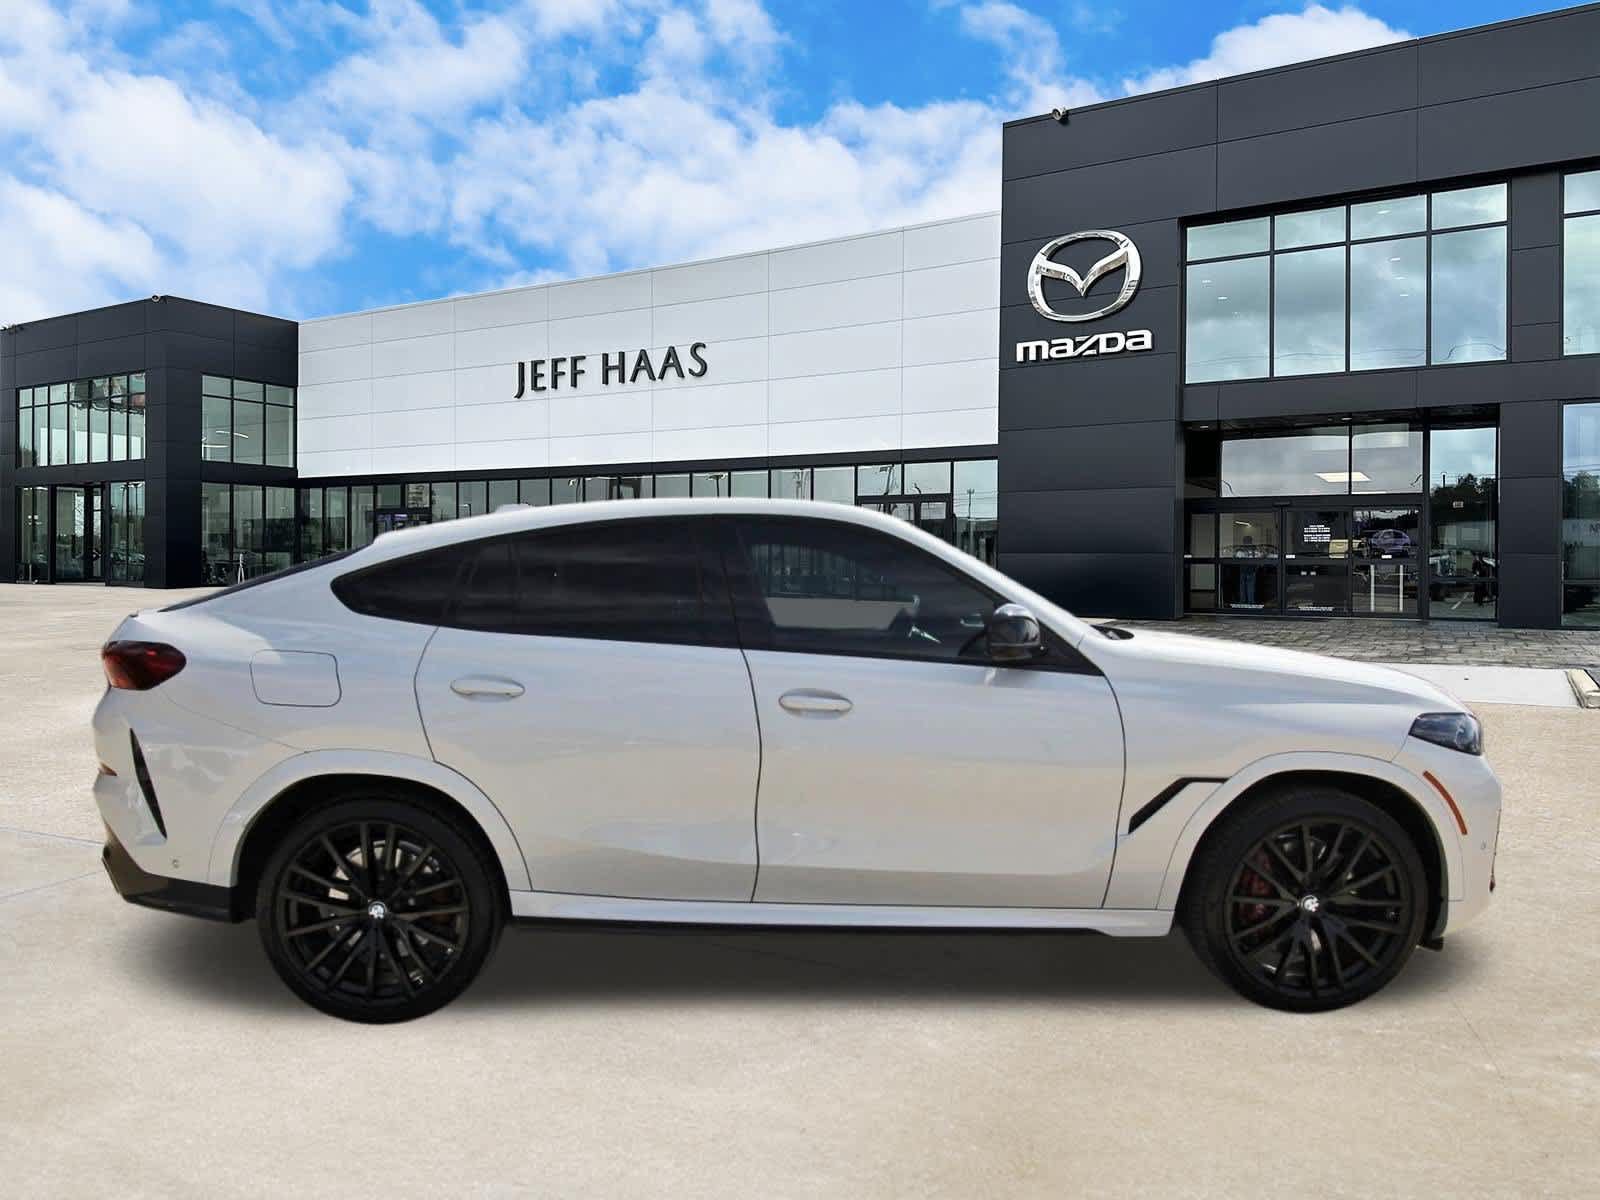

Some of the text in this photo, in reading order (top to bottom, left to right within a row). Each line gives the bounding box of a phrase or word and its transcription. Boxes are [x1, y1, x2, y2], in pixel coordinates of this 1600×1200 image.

[1016, 329, 1153, 362] mazda
[514, 342, 708, 399] JEFF HAAS
